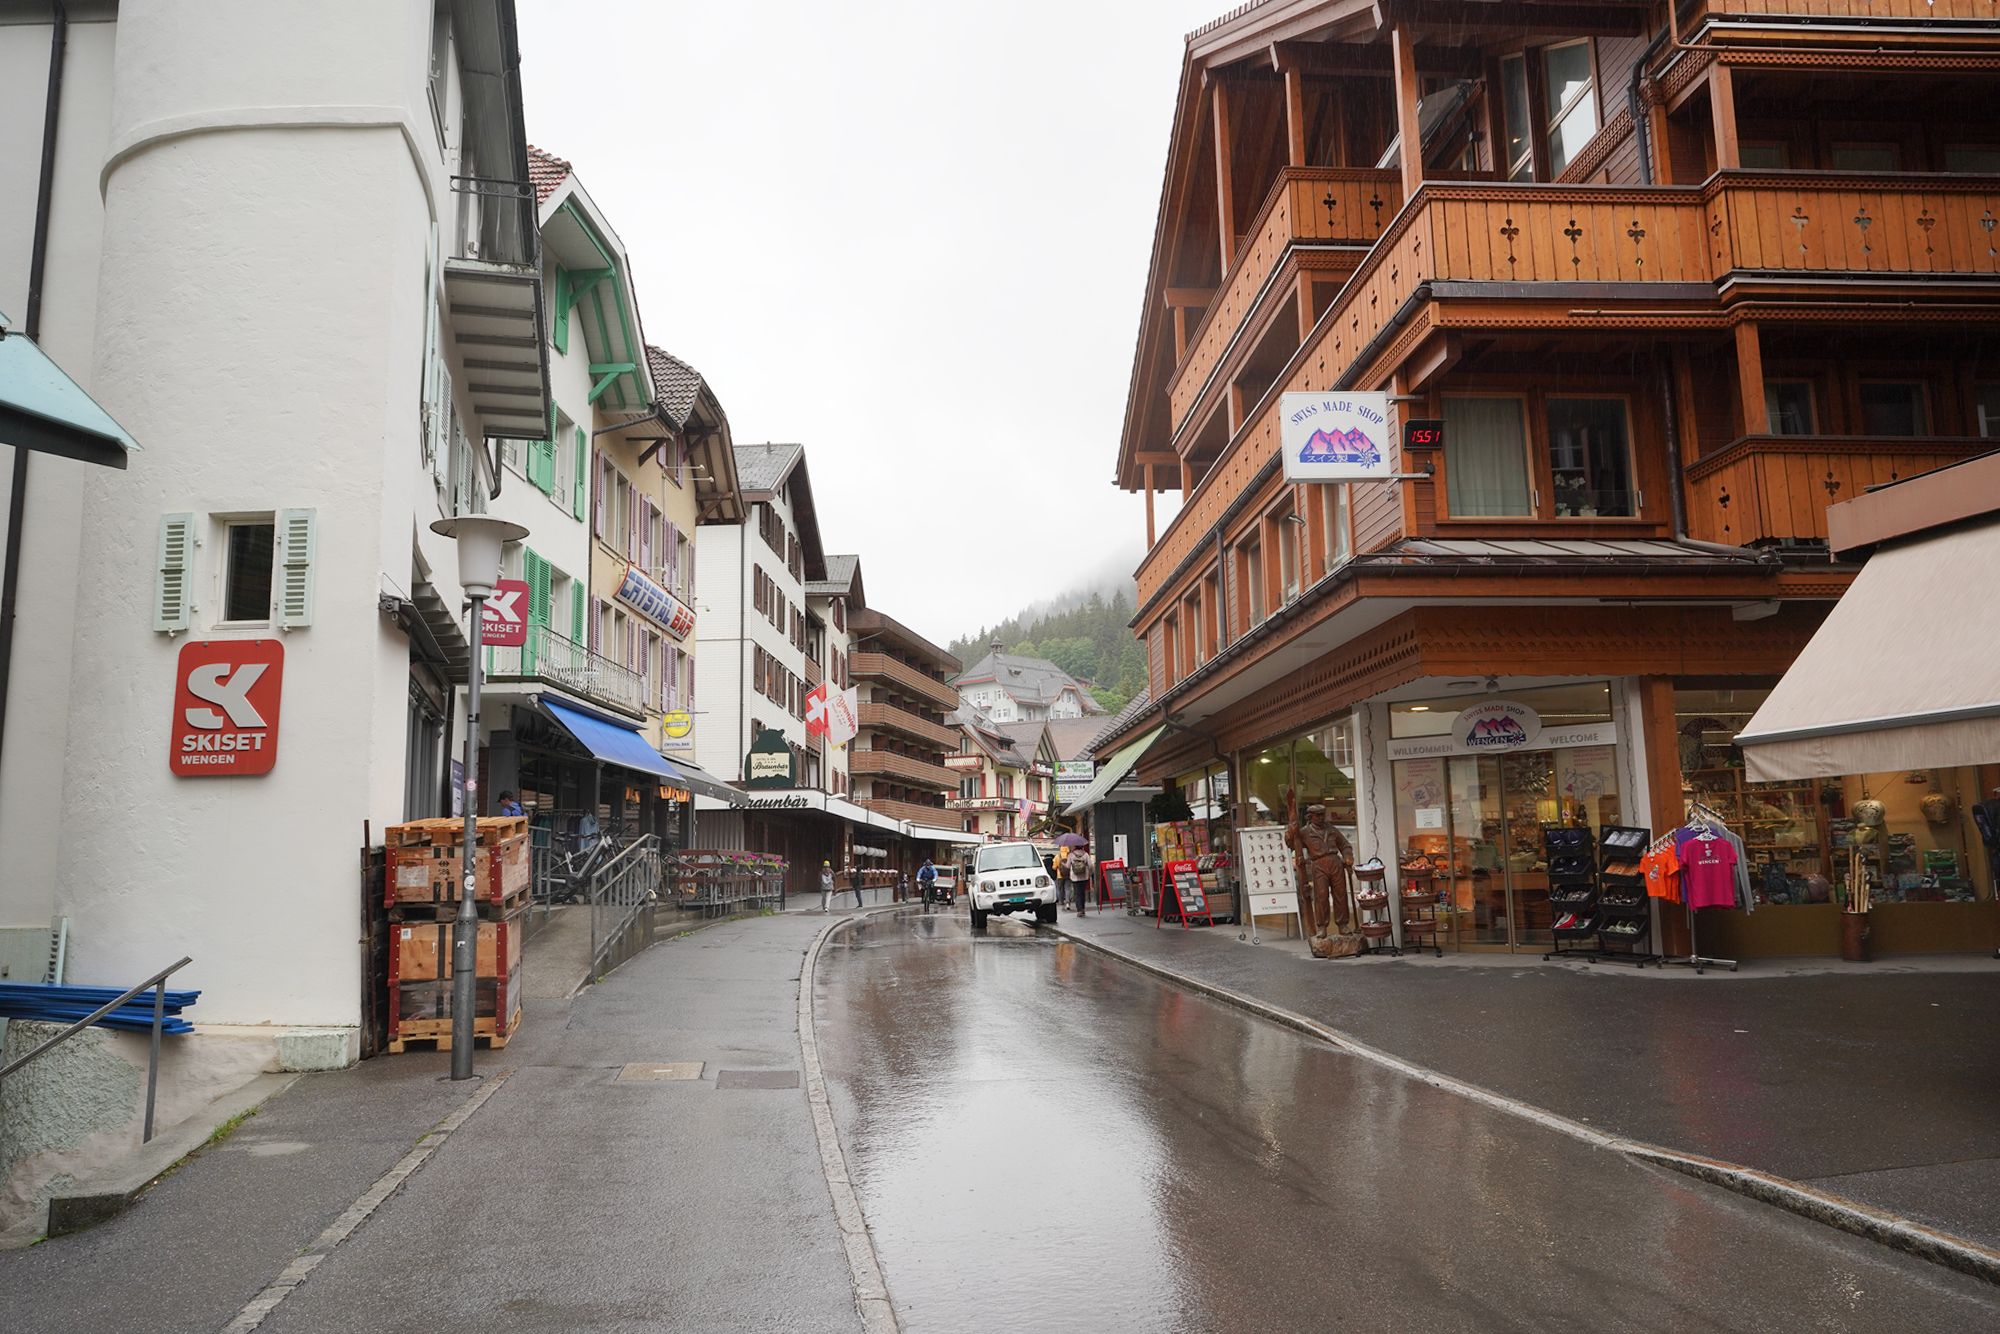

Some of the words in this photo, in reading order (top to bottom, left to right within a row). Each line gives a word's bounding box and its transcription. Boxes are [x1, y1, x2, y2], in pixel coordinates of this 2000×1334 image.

[1290, 404, 1318, 426] SWISS
[1322, 400, 1353, 413] MADE
[1356, 405, 1384, 425] SHOP
[1307, 454, 1349, 463] スイス製
[620, 571, 672, 625] CRYSTAL
[669, 606, 696, 638] BAR
[185, 662, 271, 730] SK
[1463, 708, 1483, 722] SWISS
[1484, 705, 1505, 713] MADE
[1506, 705, 1525, 716] SHOP
[181, 733, 267, 753] SKISET
[1467, 736, 1508, 746] WENGEN
[1550, 733, 1599, 745] WELCOME
[1393, 744, 1453, 757] WILLKOMMEN
[180, 754, 236, 765] WENGEN
[980, 800, 1000, 808] SPORT
